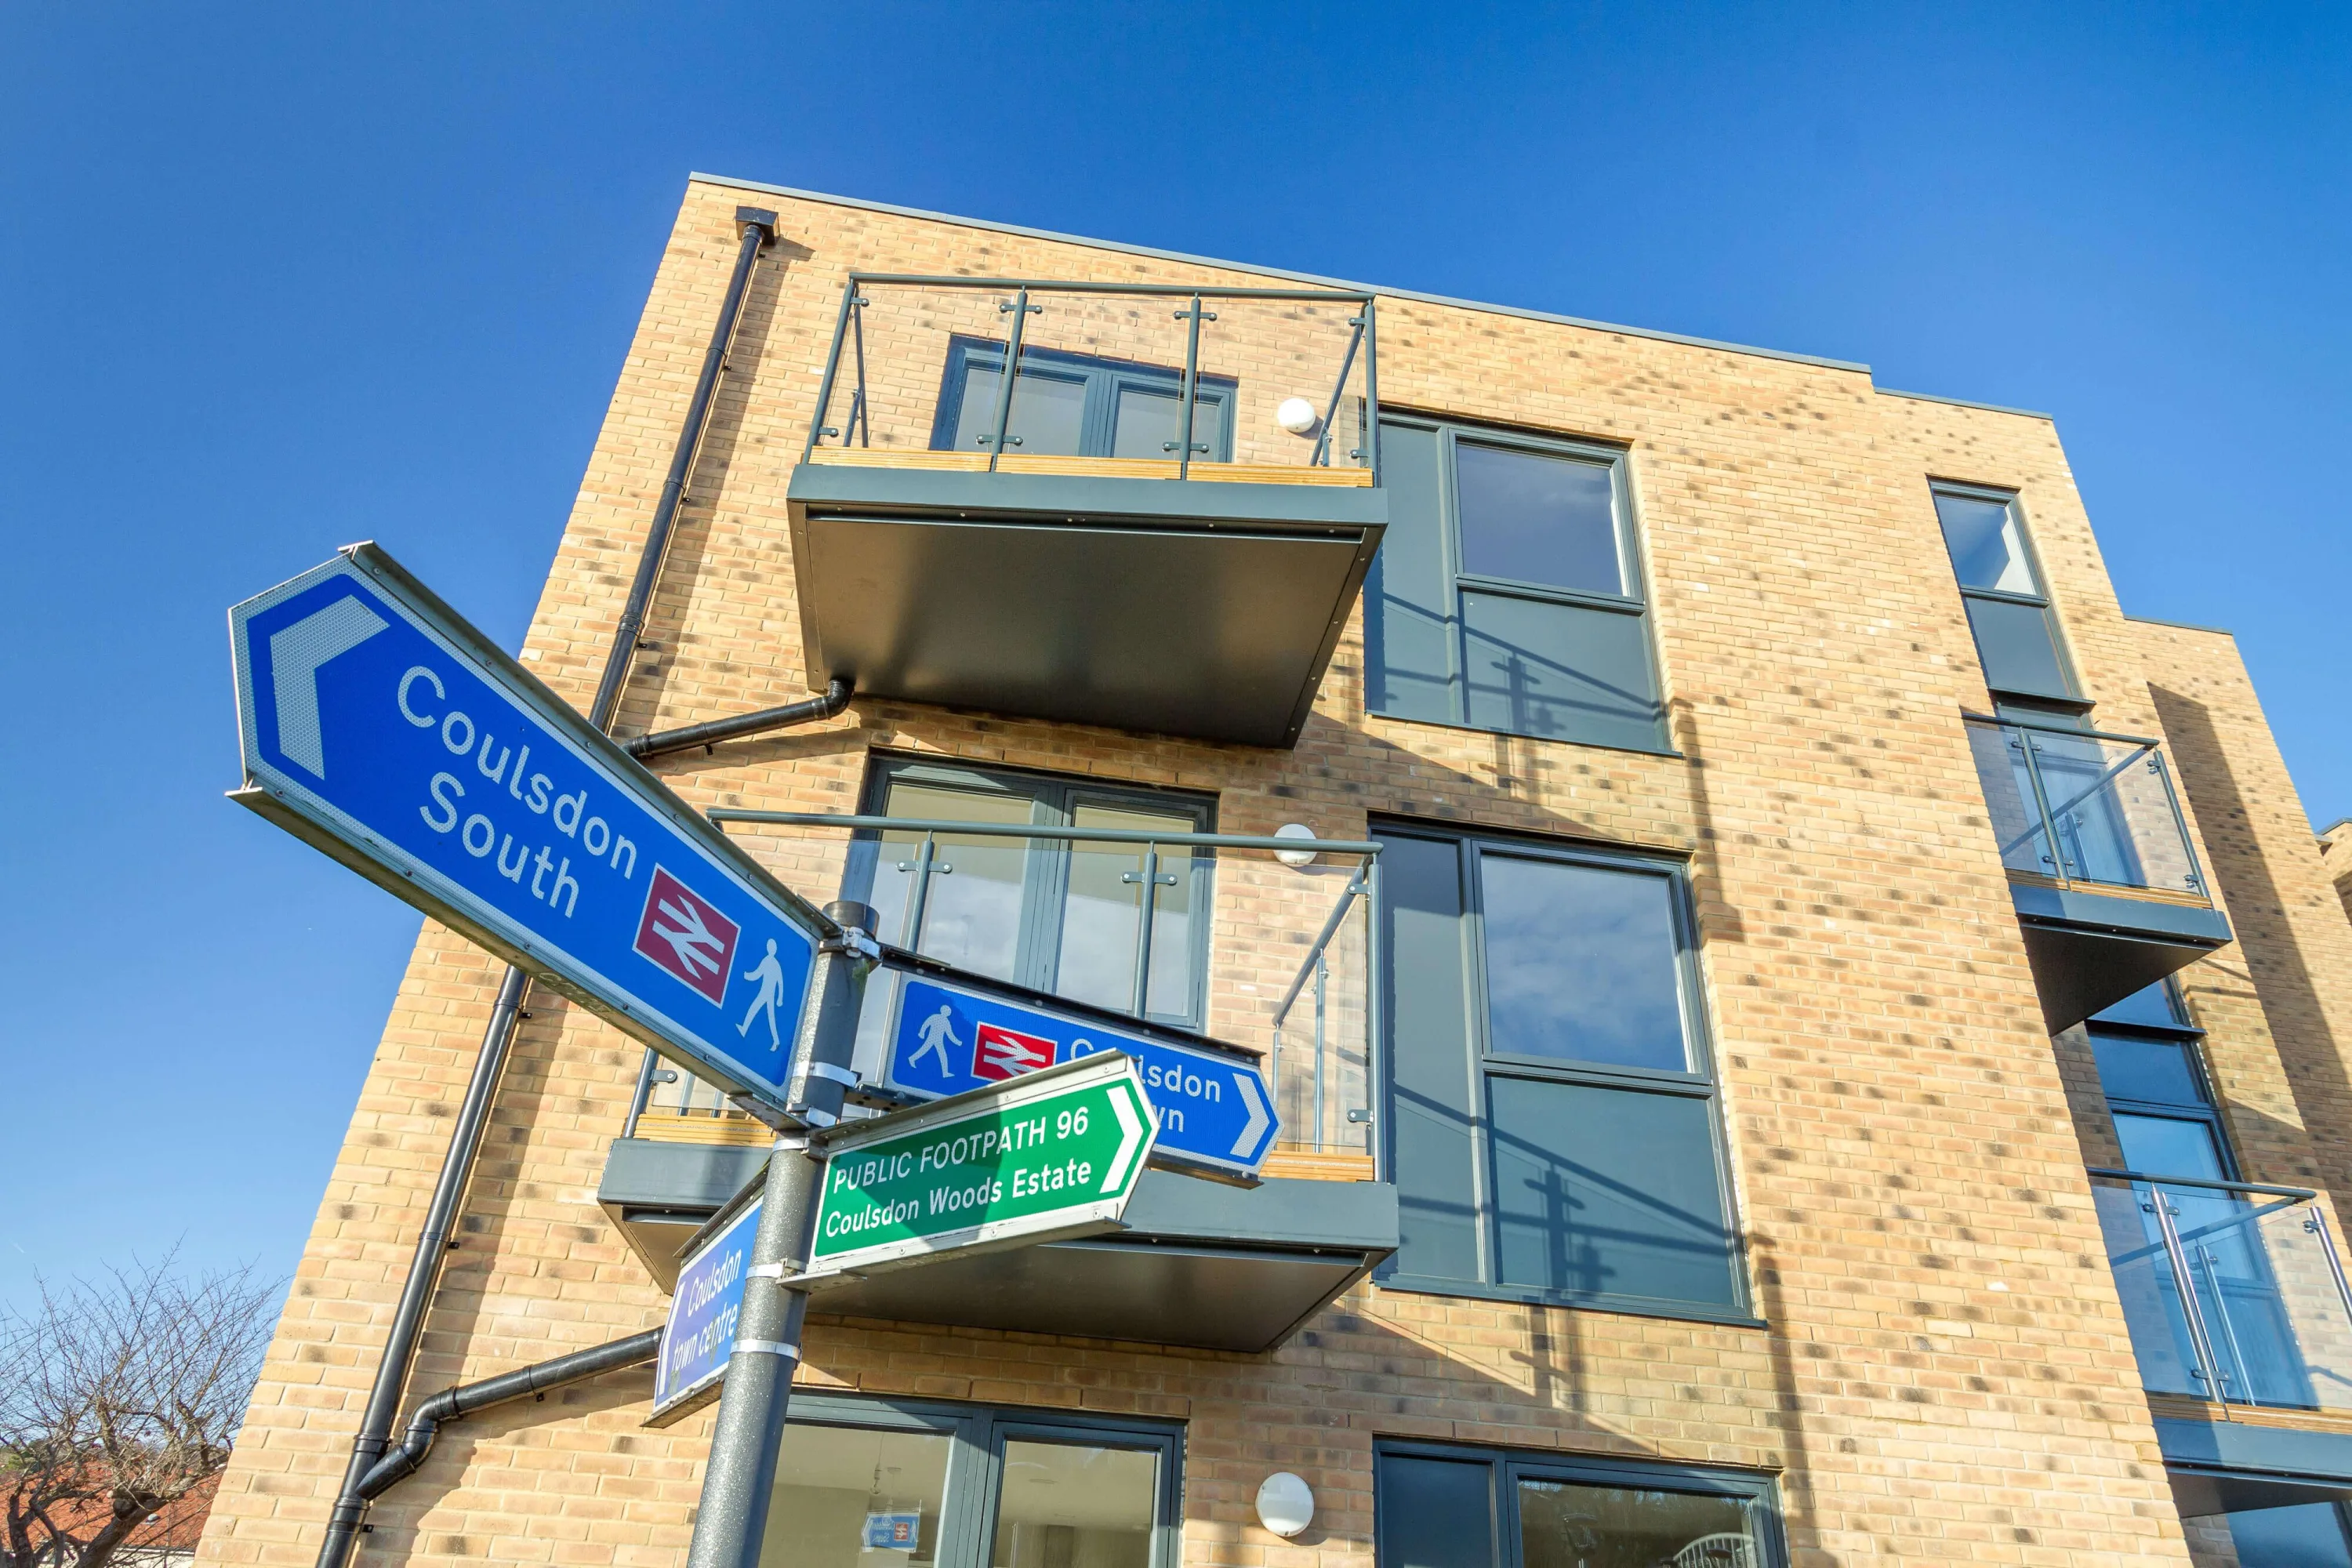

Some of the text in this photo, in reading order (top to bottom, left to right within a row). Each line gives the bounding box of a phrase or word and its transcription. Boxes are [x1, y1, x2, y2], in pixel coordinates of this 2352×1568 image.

[397, 665, 638, 879] Coulsdon
[419, 771, 581, 919] South
[1070, 1038, 1221, 1102] Clsdon
[833, 1106, 1089, 1194] PUBLIC FOOTPATH 96
[826, 1158, 1092, 1238] Coulsdon Woods Estate
[688, 1248, 742, 1318] Coulsdon
[672, 1301, 739, 1372] town centre
